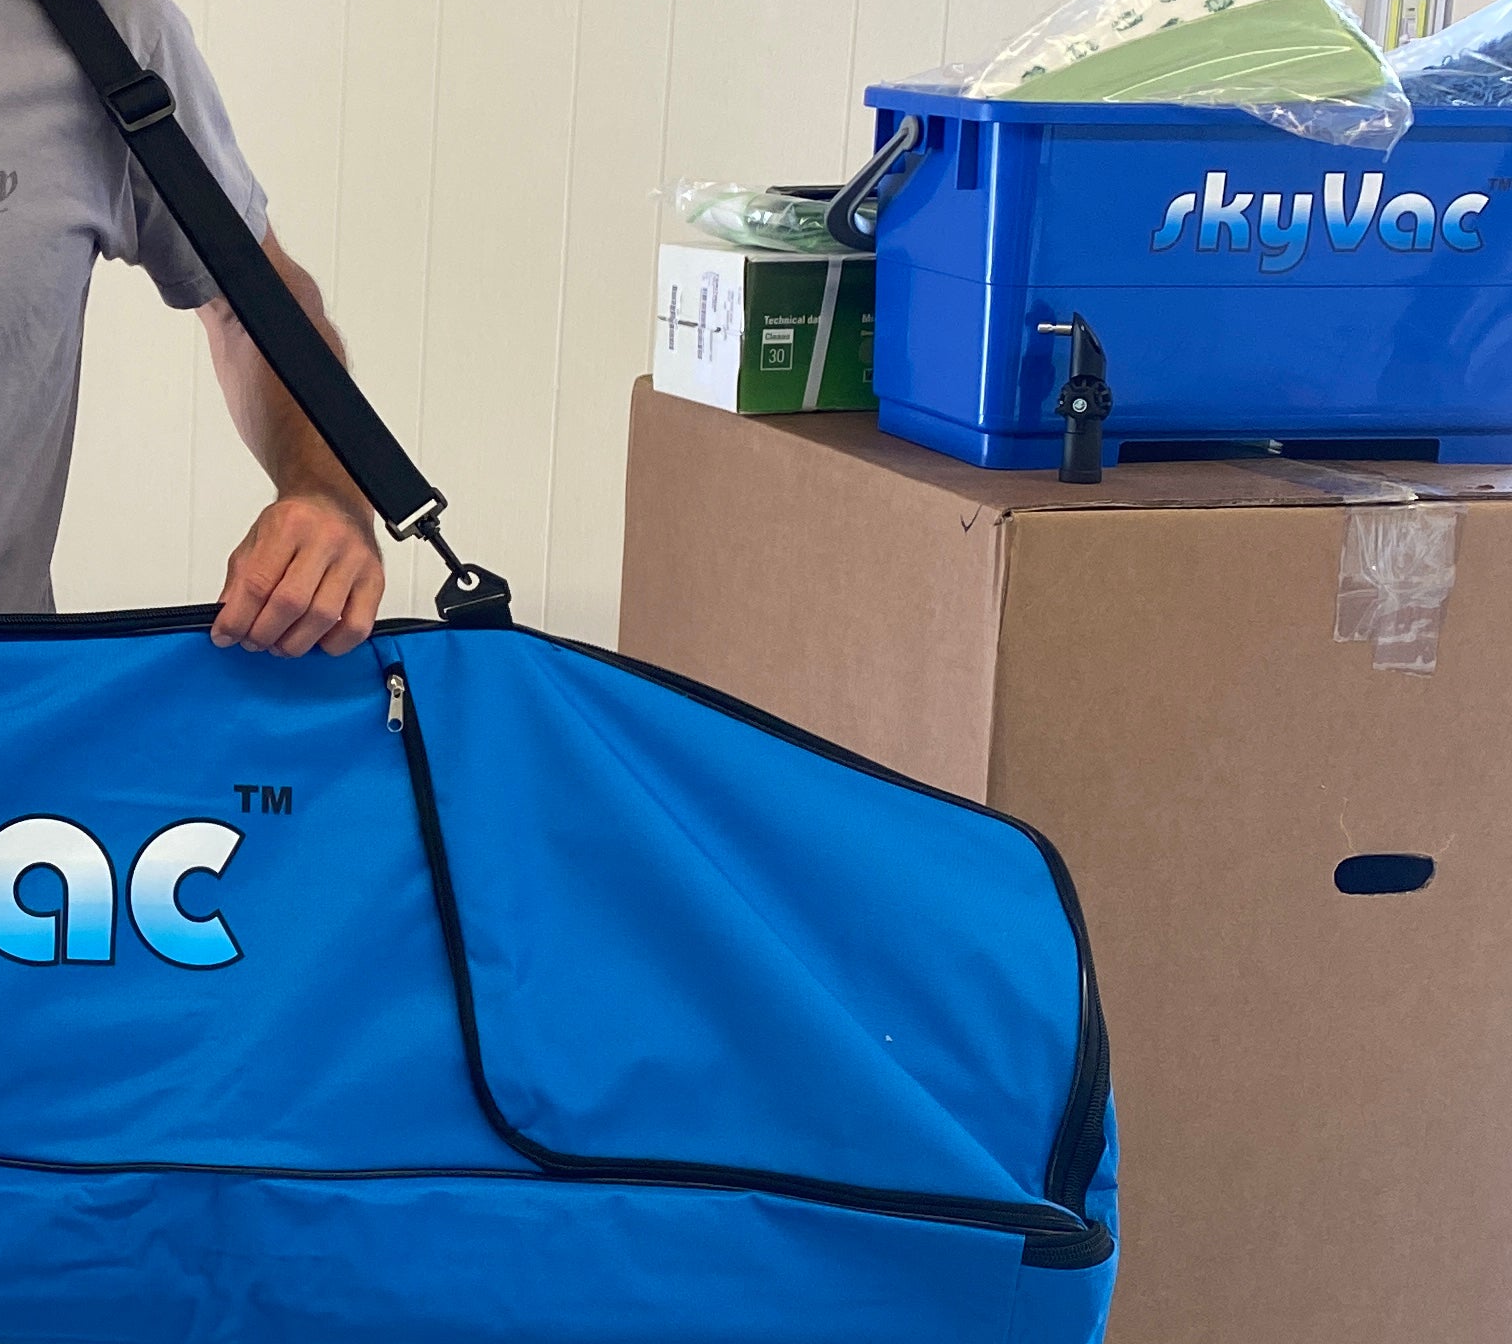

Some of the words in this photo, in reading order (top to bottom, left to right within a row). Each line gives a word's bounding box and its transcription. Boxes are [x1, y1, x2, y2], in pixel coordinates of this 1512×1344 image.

[1150, 171, 1490, 275] skyVac
[764, 314, 806, 326] Technical
[768, 348, 785, 364] 30
[233, 784, 293, 815] TM
